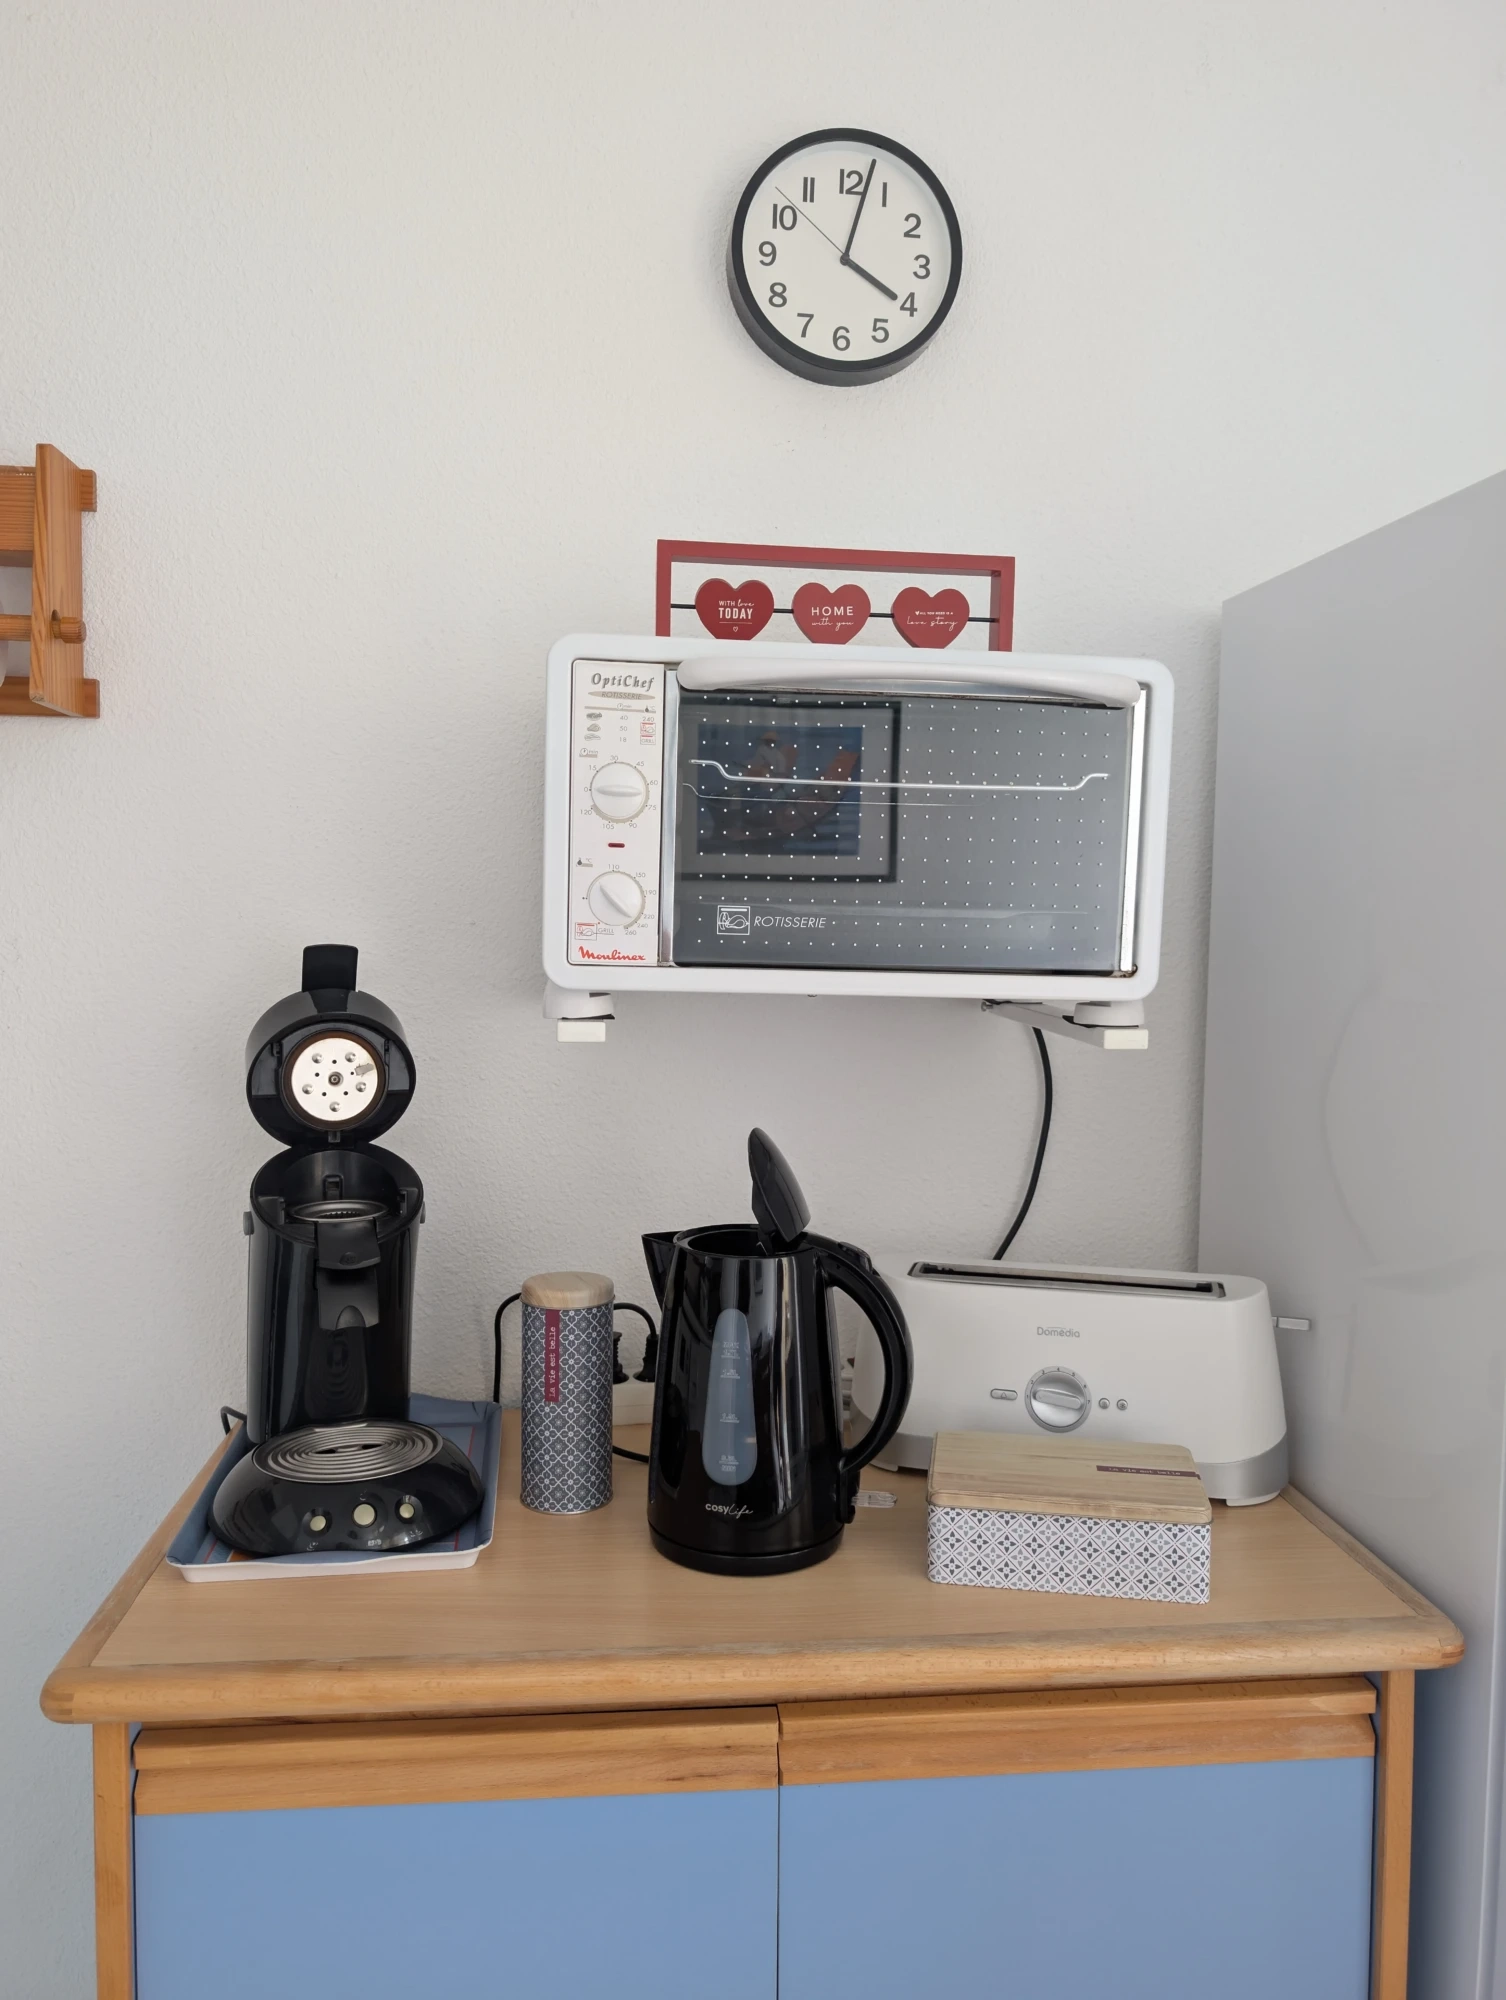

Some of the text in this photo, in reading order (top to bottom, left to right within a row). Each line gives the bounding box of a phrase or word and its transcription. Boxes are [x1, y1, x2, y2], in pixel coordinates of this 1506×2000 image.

[802, 176, 815, 203] 11
[838, 168, 864, 196] 12
[881, 181, 888, 207] 1
[772, 203, 797, 231] 10
[903, 213, 922, 239] 2
[758, 240, 777, 266] 9
[912, 254, 931, 280] 3
[768, 282, 787, 308] 8
[899, 292, 918, 317] 4
[796, 312, 814, 338] 7
[832, 325, 850, 351] 6
[871, 317, 890, 343] 5
[718, 607, 753, 619] TODAY
[737, 598, 755, 607] love
[811, 606, 854, 616] HOME
[811, 617, 854, 632] with you
[930, 616, 958, 632] story
[590, 673, 654, 692] OptiChef
[601, 692, 642, 700] ROTISSERIE
[753, 915, 827, 928] ROTISSERIE
[578, 945, 646, 961] Moulinex
